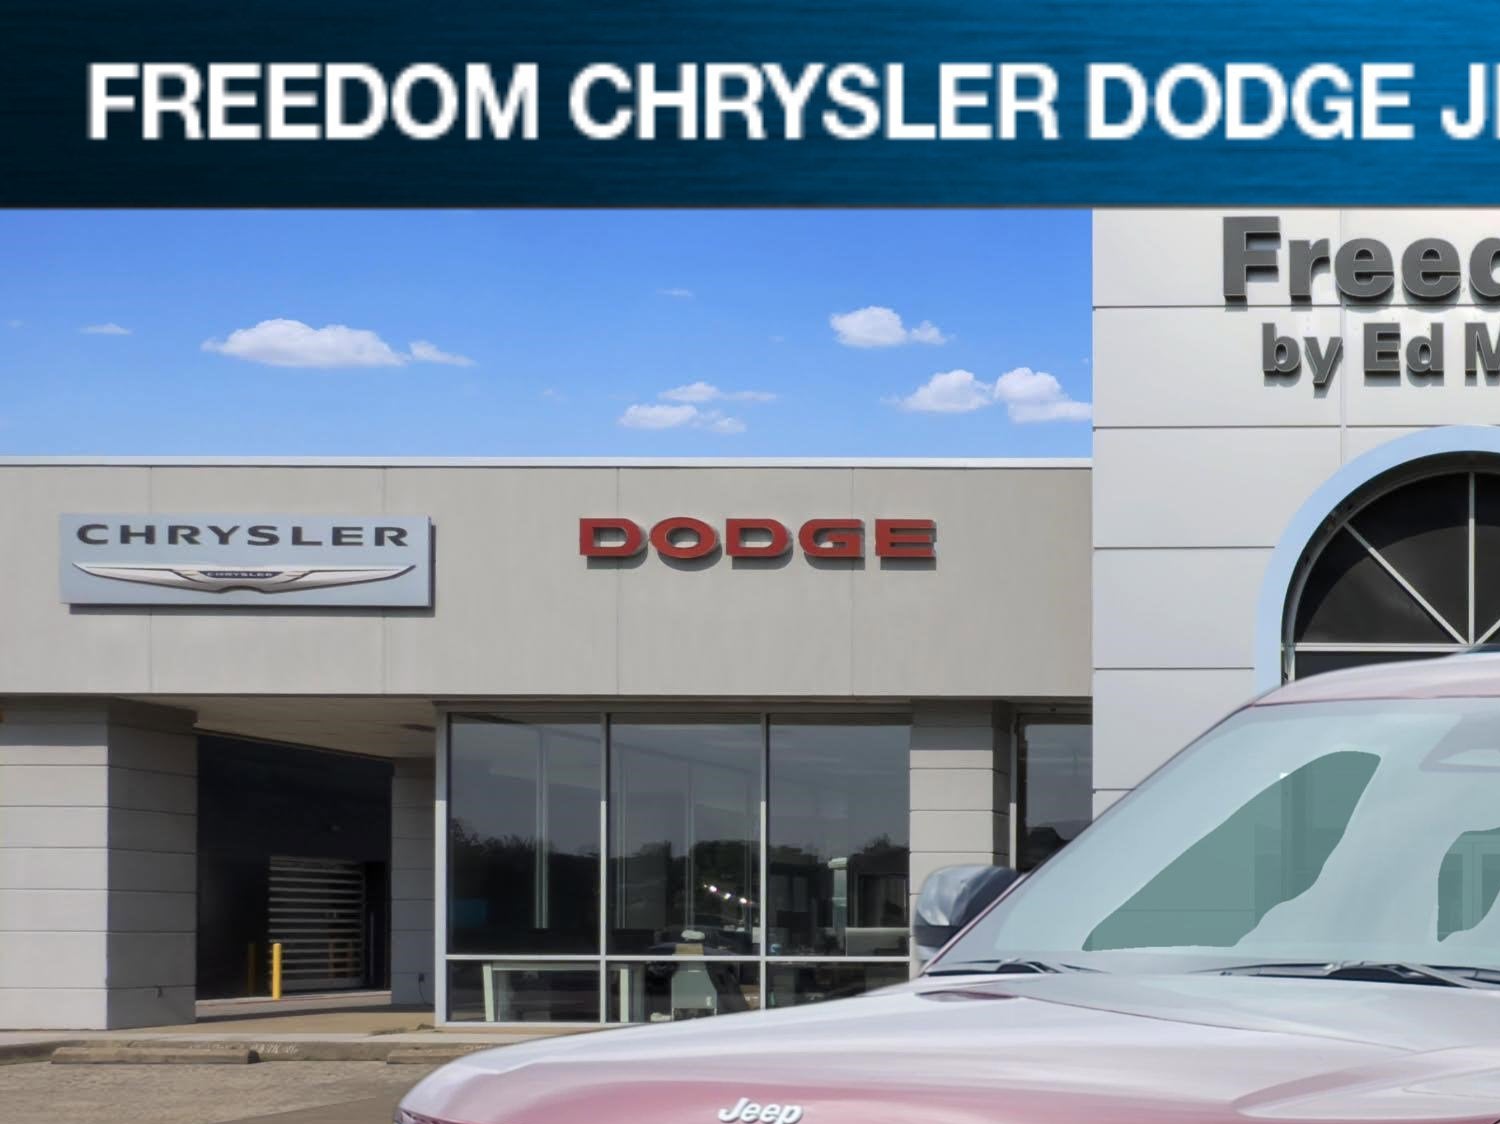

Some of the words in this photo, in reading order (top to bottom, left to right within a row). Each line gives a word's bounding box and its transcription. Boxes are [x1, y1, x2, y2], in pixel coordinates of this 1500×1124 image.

[1261, 322, 1343, 389] by
[1363, 322, 1445, 377] Ed
[76, 523, 409, 547] CHRYSLER
[578, 516, 937, 560] DODGE
